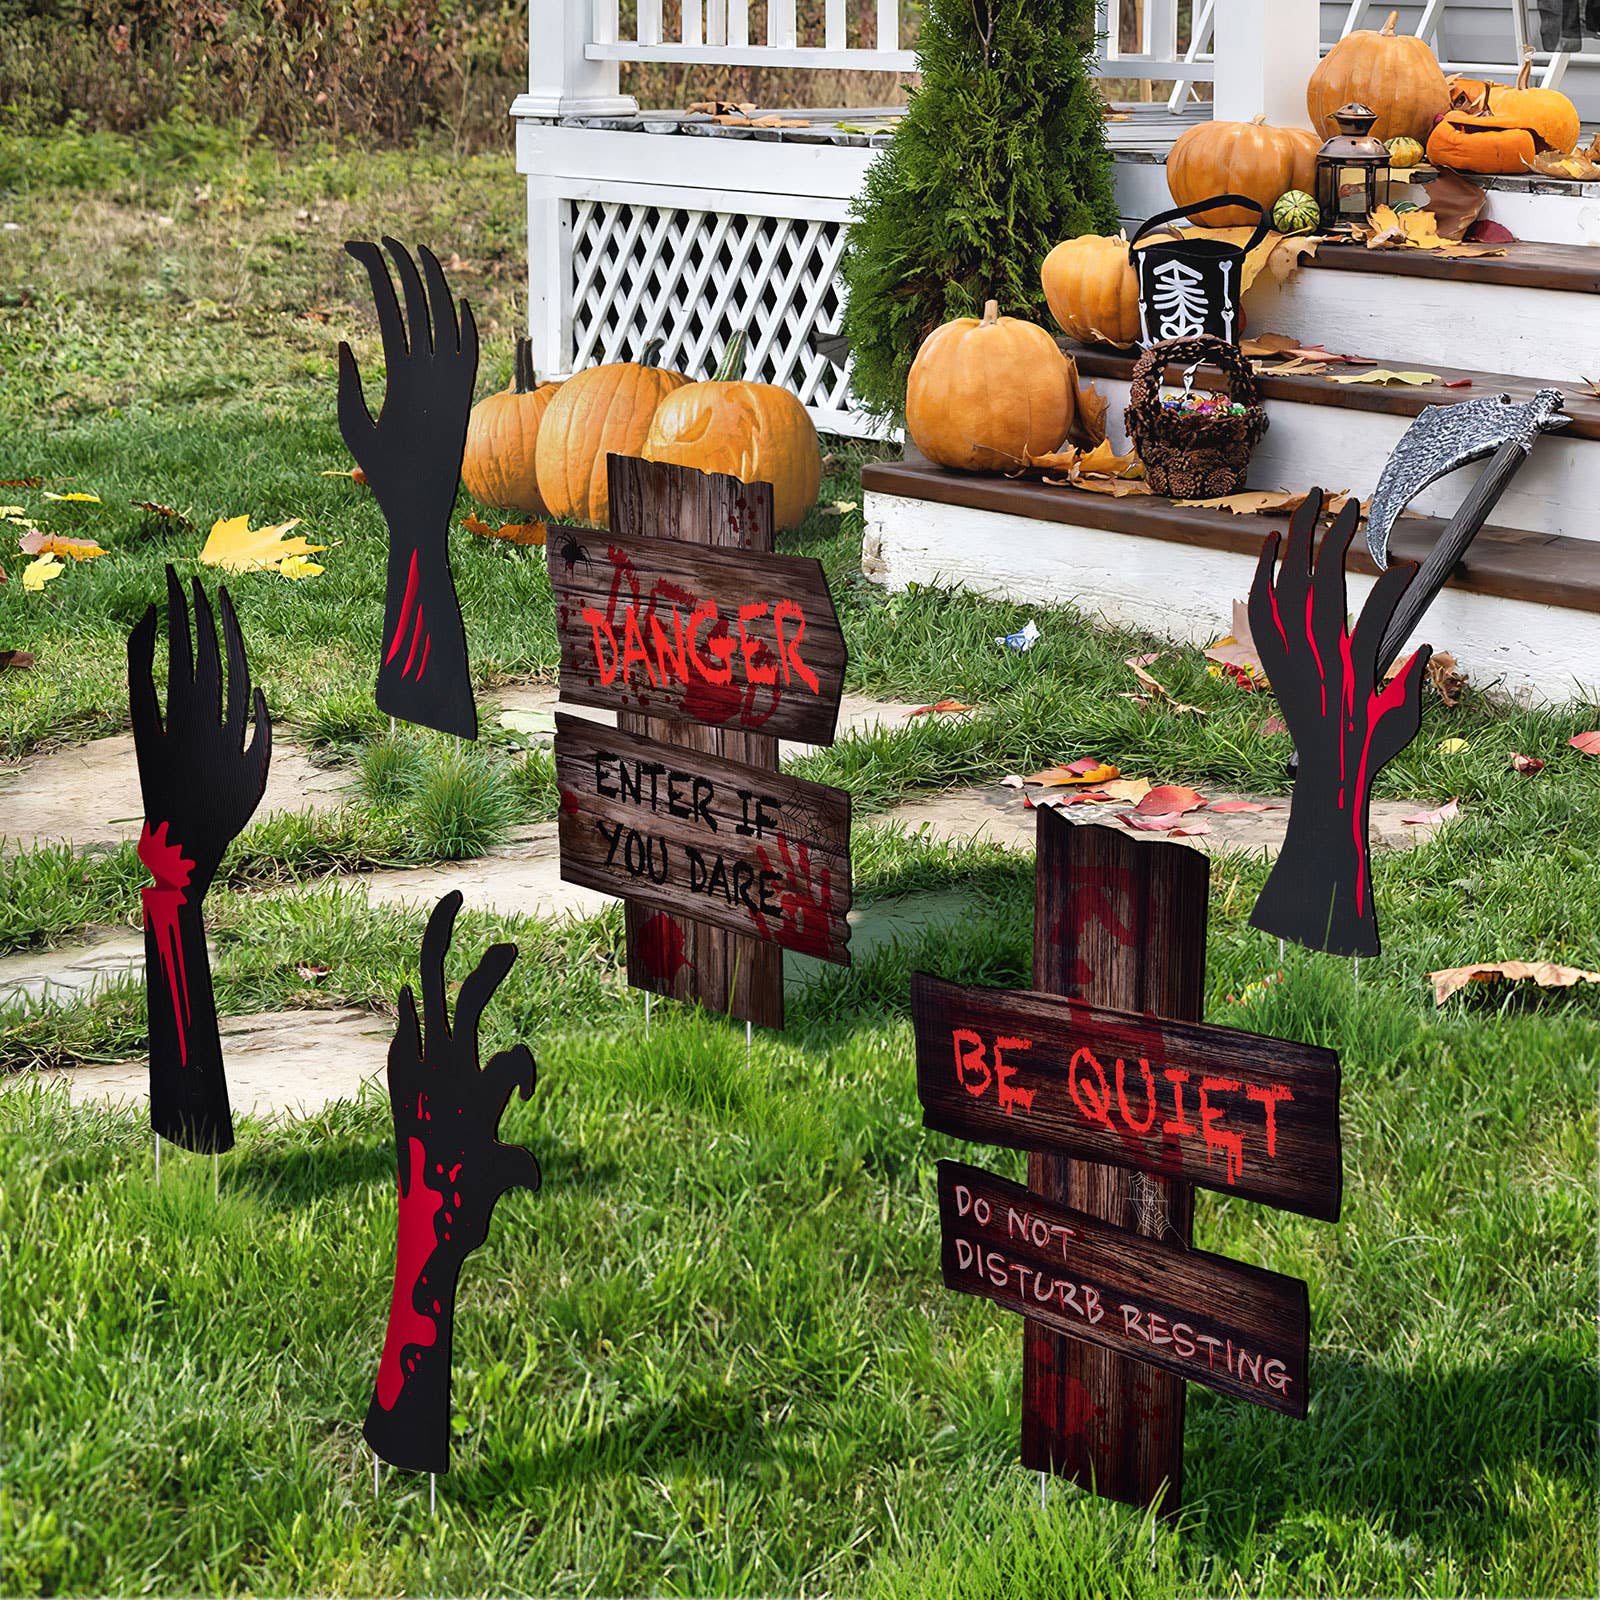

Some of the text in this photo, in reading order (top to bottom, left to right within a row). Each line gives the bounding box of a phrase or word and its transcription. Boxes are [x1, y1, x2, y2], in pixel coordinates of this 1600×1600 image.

[582, 598, 820, 695] DANGER
[596, 752, 779, 840] ENTER IF
[596, 820, 784, 918] YOU DARE
[952, 1028, 1295, 1185] BE QUIET
[954, 1185, 1078, 1261] DO NOT
[955, 1238, 1294, 1396] DISTURB RESTING
